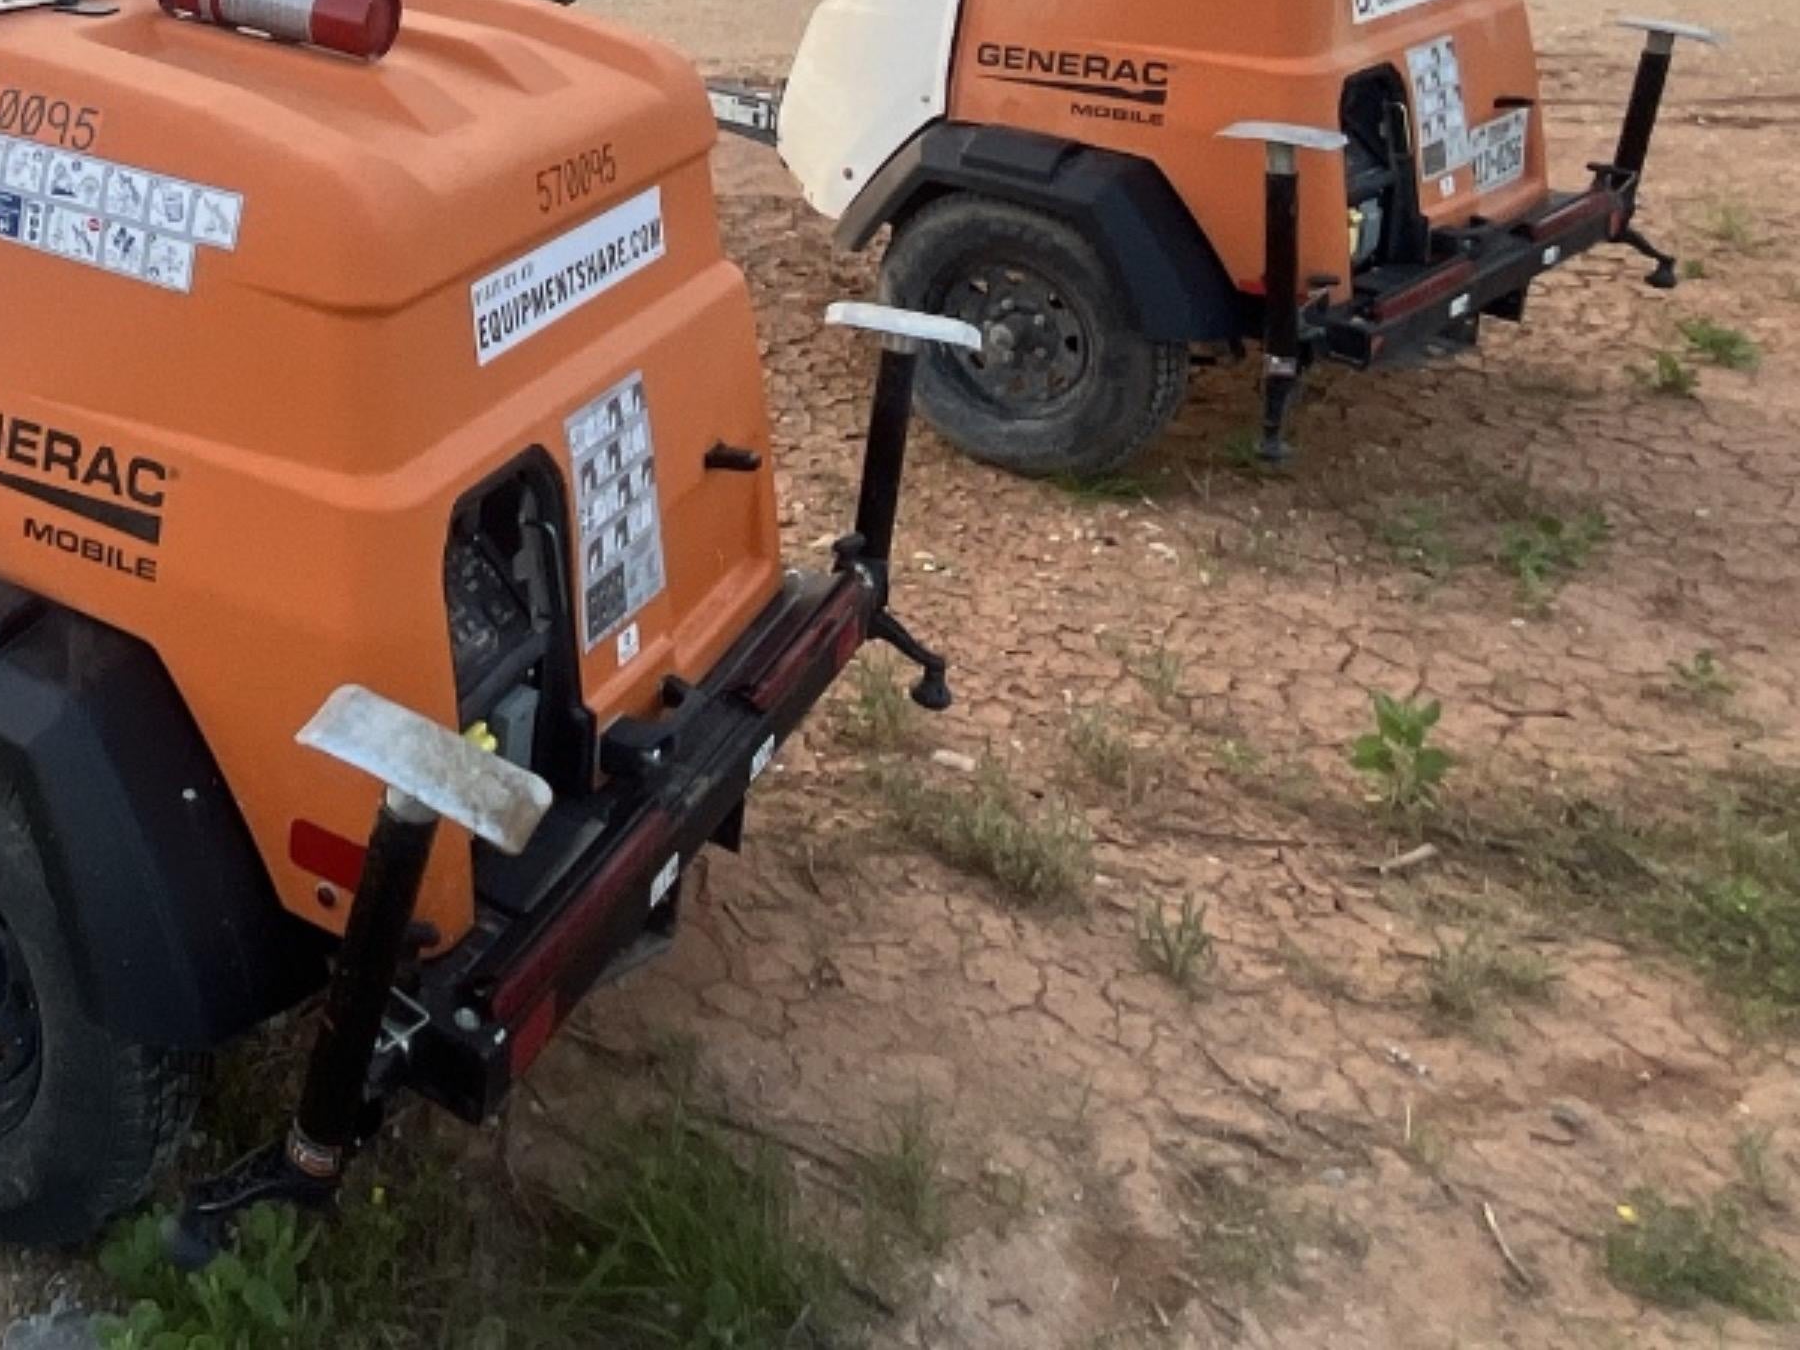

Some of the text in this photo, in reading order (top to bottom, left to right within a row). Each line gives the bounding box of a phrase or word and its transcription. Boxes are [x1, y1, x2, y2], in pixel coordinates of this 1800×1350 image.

[977, 41, 1169, 86] GENERAC
[1069, 102, 1165, 127] MOBILE
[535, 143, 617, 214] 570095
[477, 216, 662, 350] EQUIPMENTSHARE.COM
[23, 517, 158, 583] MOBILE
